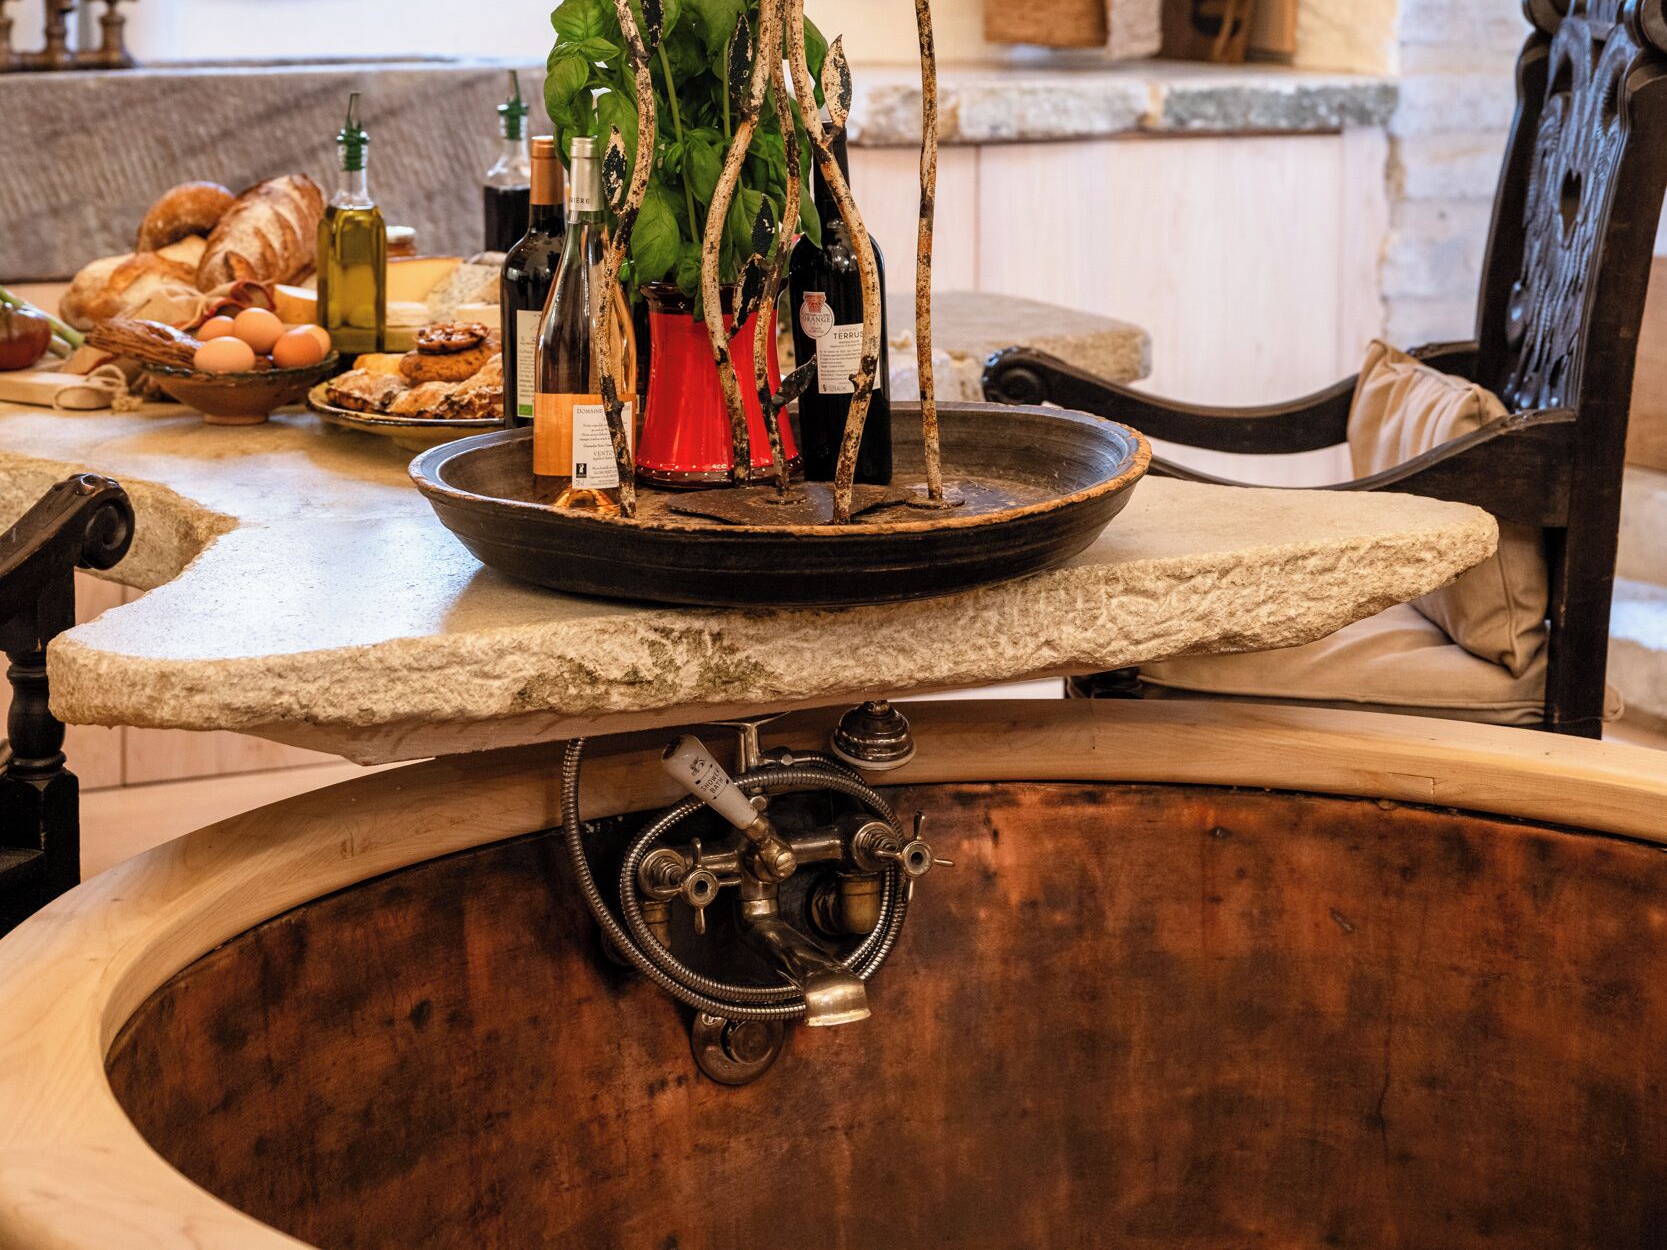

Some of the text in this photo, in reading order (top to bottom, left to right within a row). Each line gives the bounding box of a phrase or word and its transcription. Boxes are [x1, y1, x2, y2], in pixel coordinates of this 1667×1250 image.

[833, 331, 863, 339] TERRUS
[700, 768, 720, 791] SHOWER
[709, 777, 724, 794] BATH
